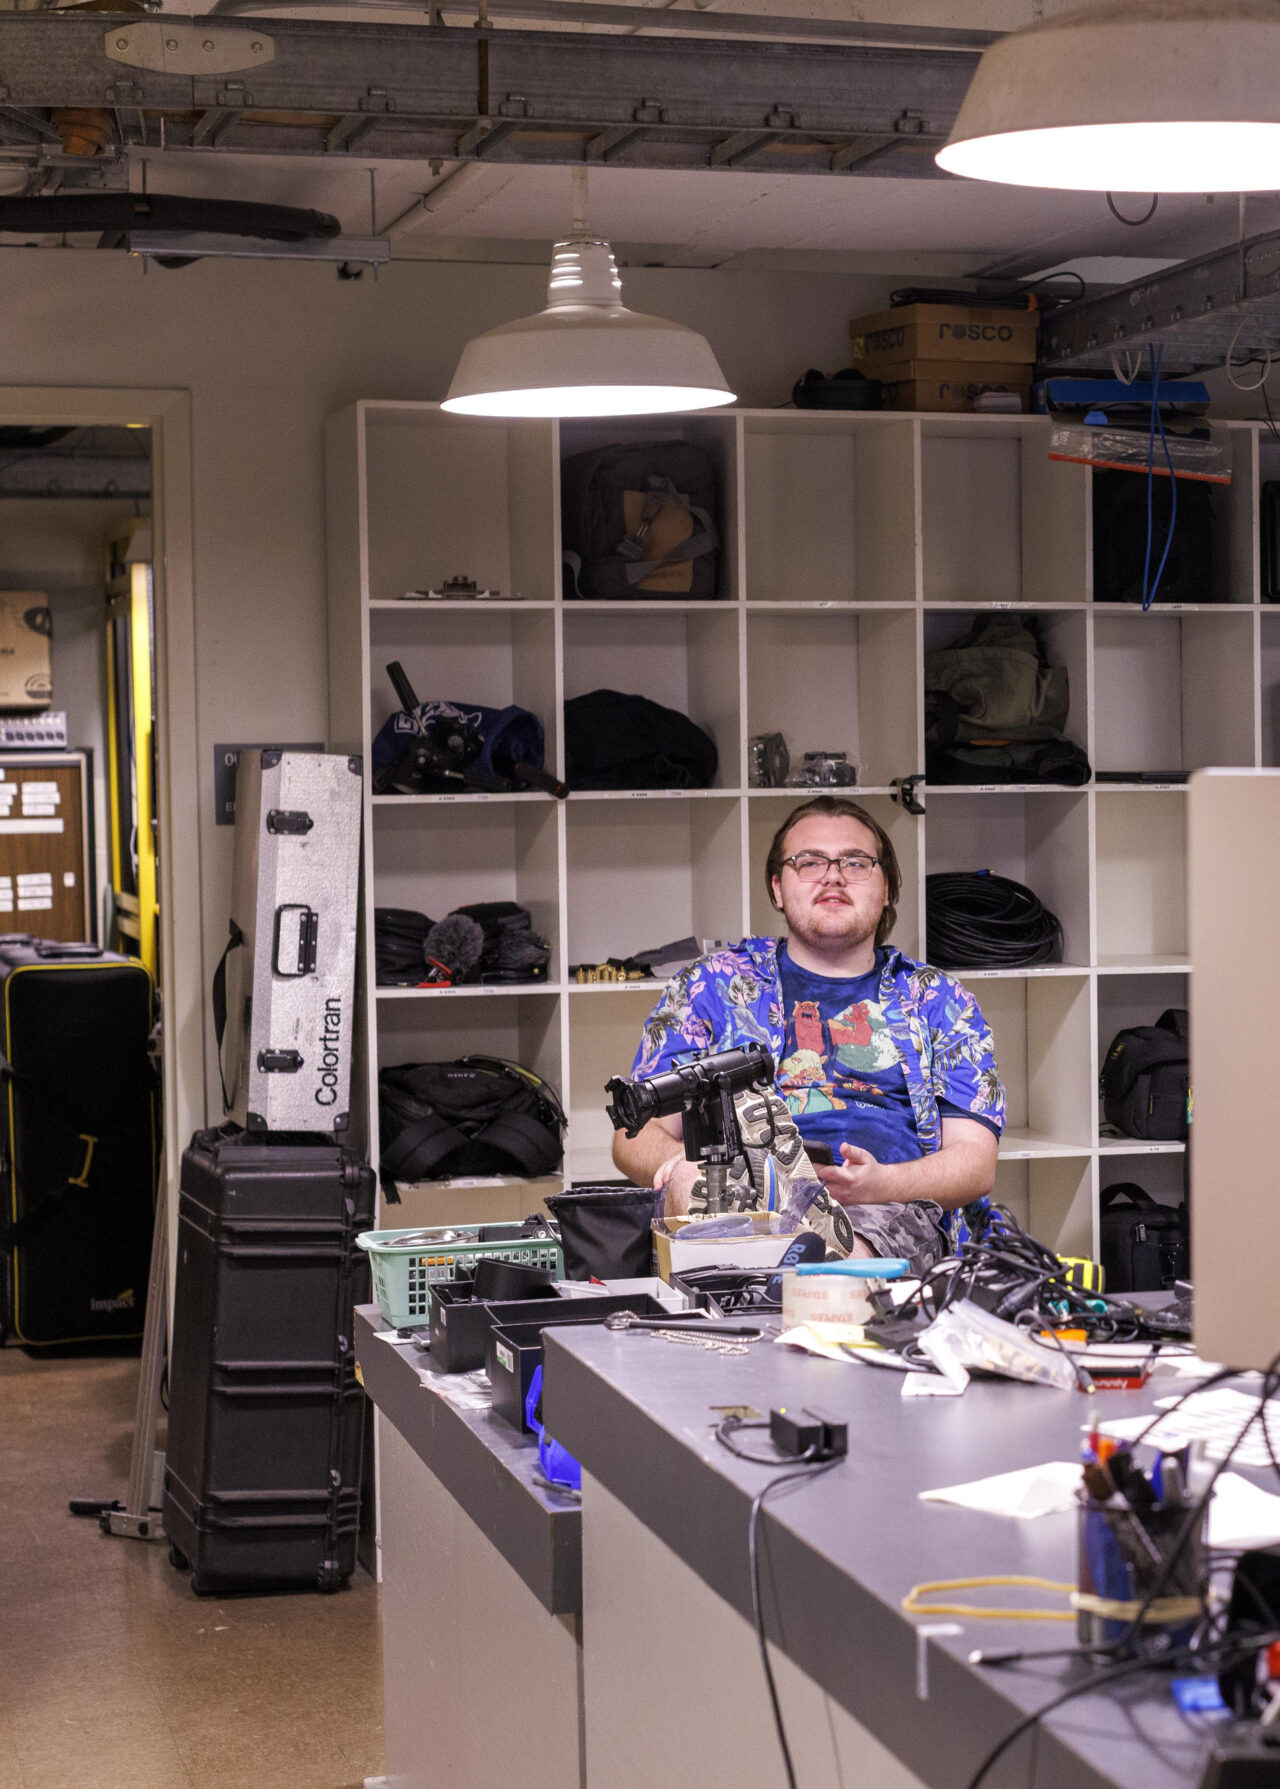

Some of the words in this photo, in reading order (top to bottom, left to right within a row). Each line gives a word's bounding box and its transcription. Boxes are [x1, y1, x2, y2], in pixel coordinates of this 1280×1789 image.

[938, 323, 1013, 342] rosco
[314, 998, 341, 1106] Colortran
[772, 1243, 806, 1284] RØE
